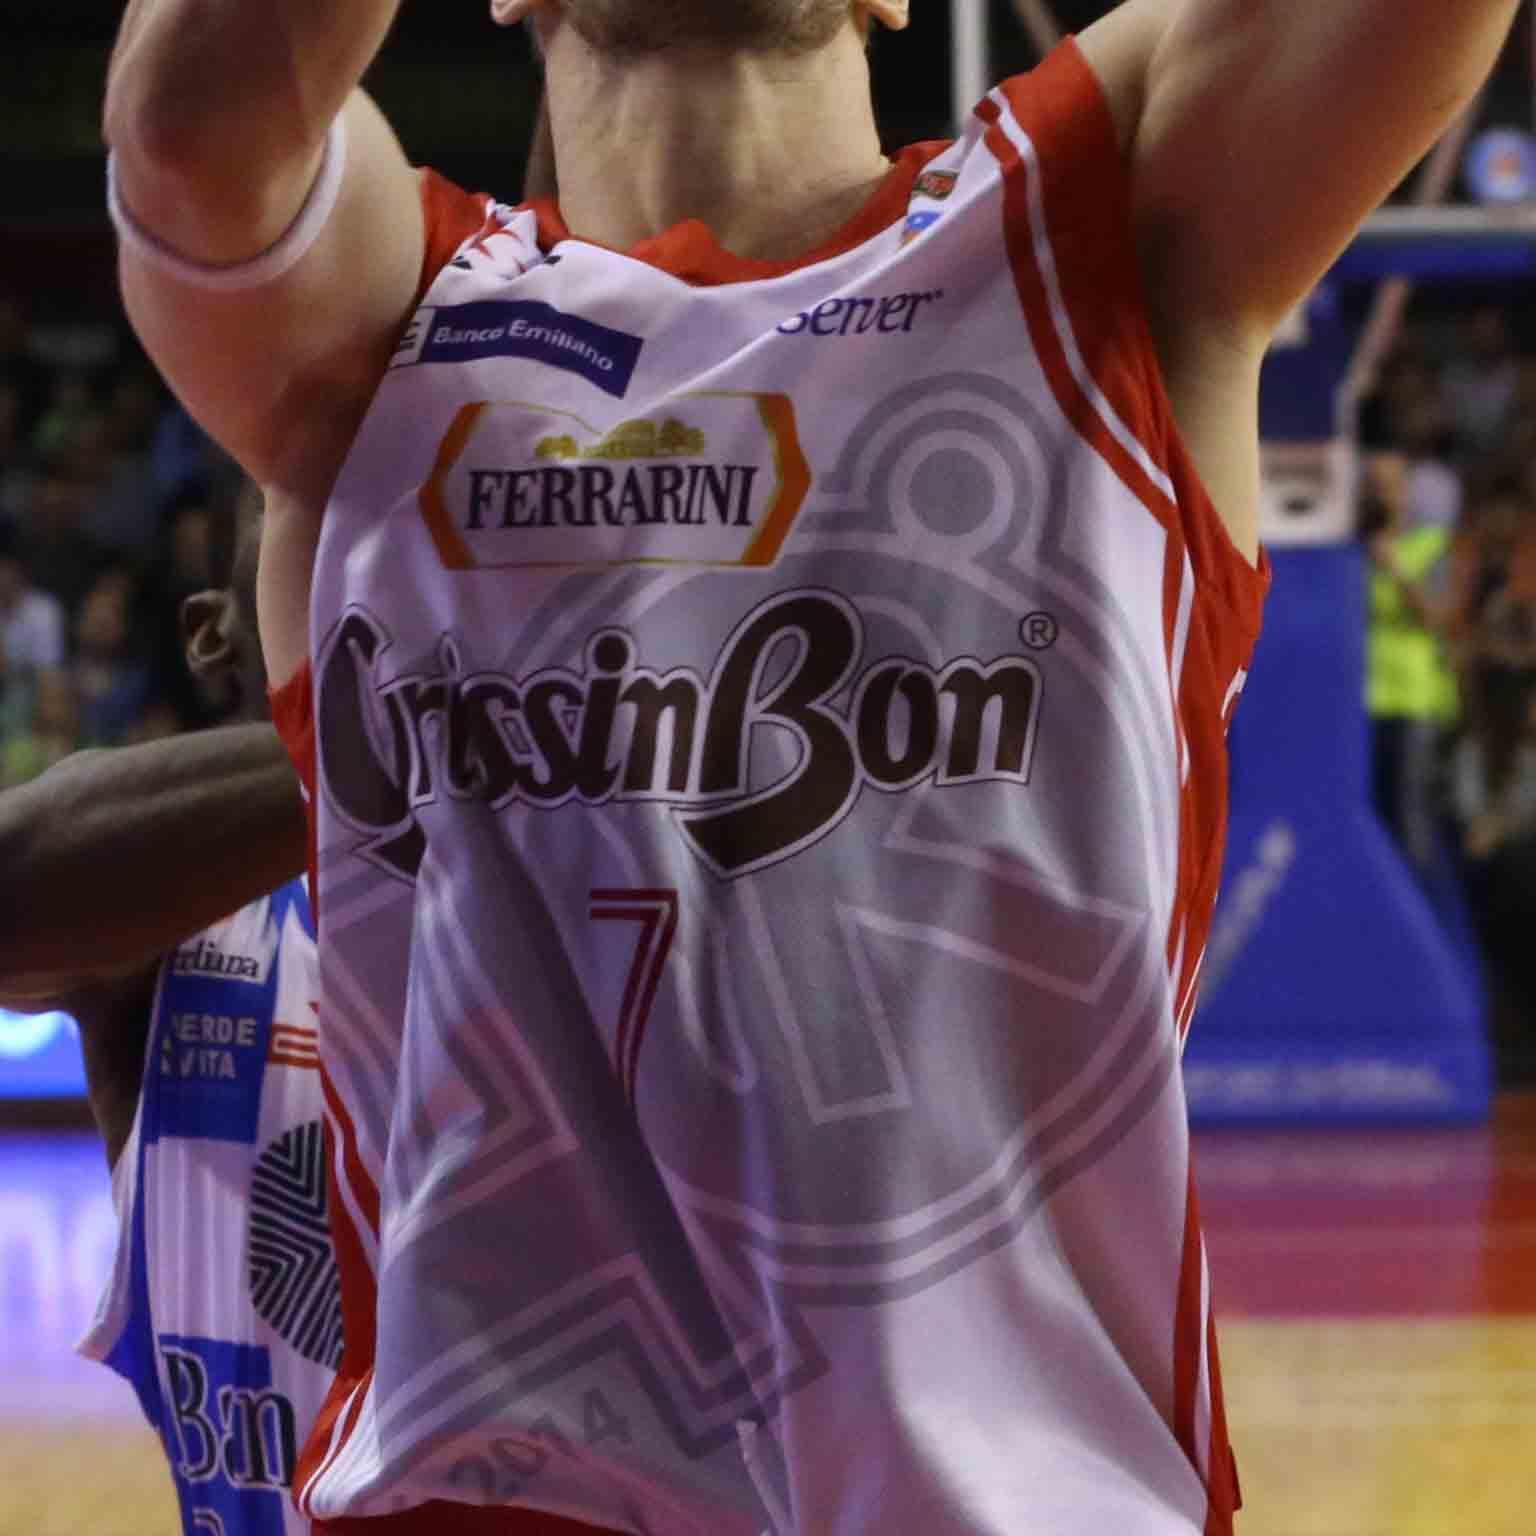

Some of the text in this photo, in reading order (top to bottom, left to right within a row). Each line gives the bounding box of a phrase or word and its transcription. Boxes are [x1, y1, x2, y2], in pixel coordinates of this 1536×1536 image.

[433, 325, 505, 345] Banco
[507, 319, 614, 372] Emiliano
[466, 463, 756, 530] FERRARINI
[589, 887, 677, 1106] 7
